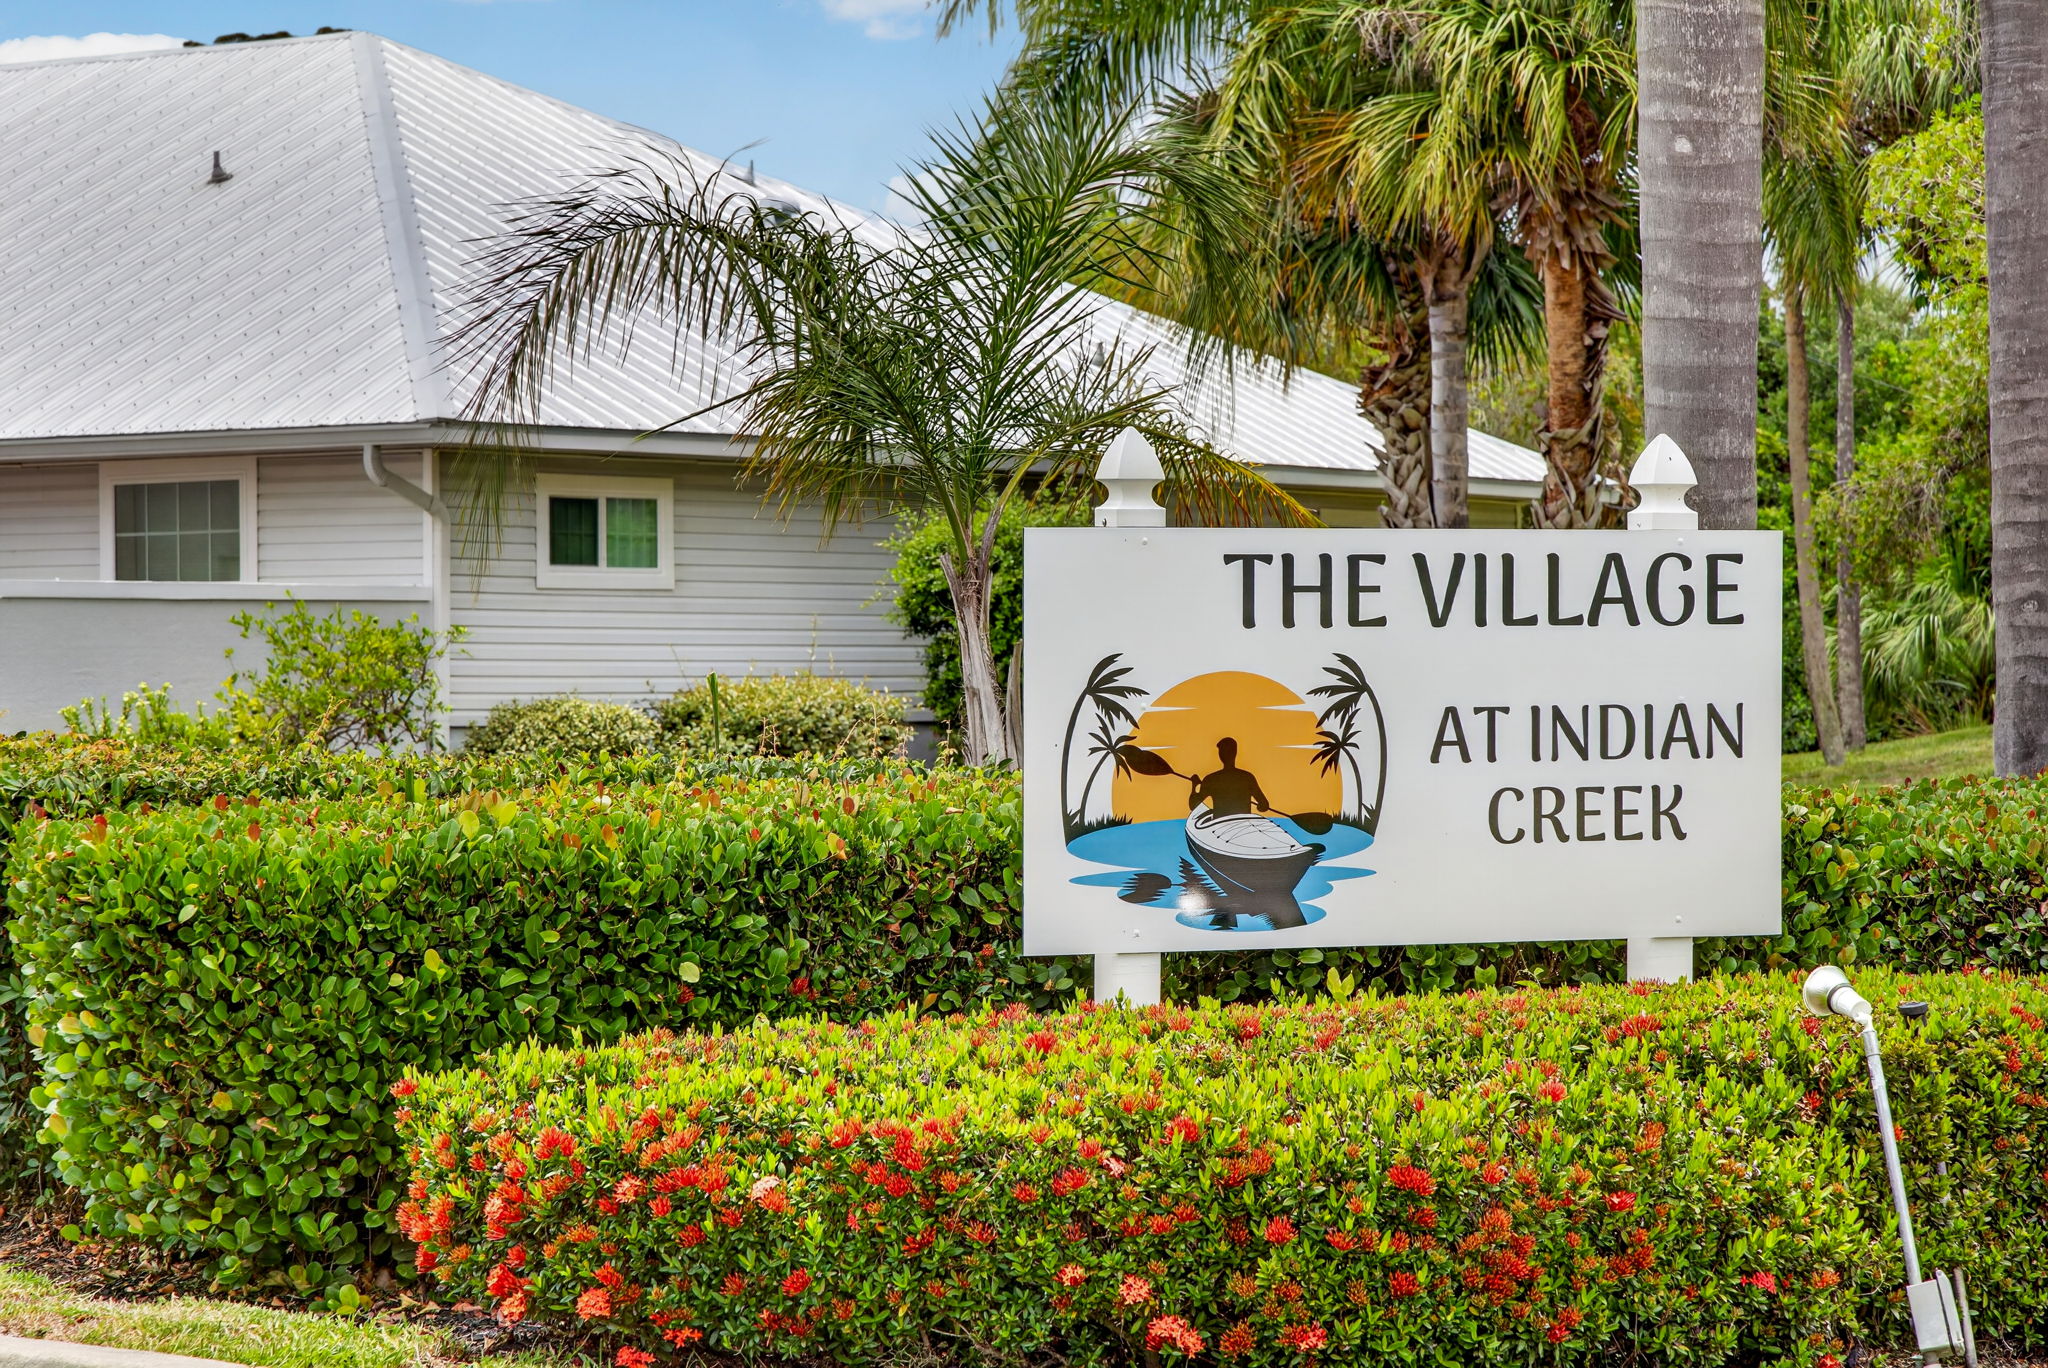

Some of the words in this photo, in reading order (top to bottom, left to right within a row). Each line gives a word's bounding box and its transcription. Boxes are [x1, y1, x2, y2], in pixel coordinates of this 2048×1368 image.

[1223, 553, 1388, 630] THE
[1411, 552, 1745, 628] VILLAGE
[1429, 706, 1511, 764] AT
[1530, 702, 1744, 763] INDIAN
[1488, 784, 1688, 845] CREEK
